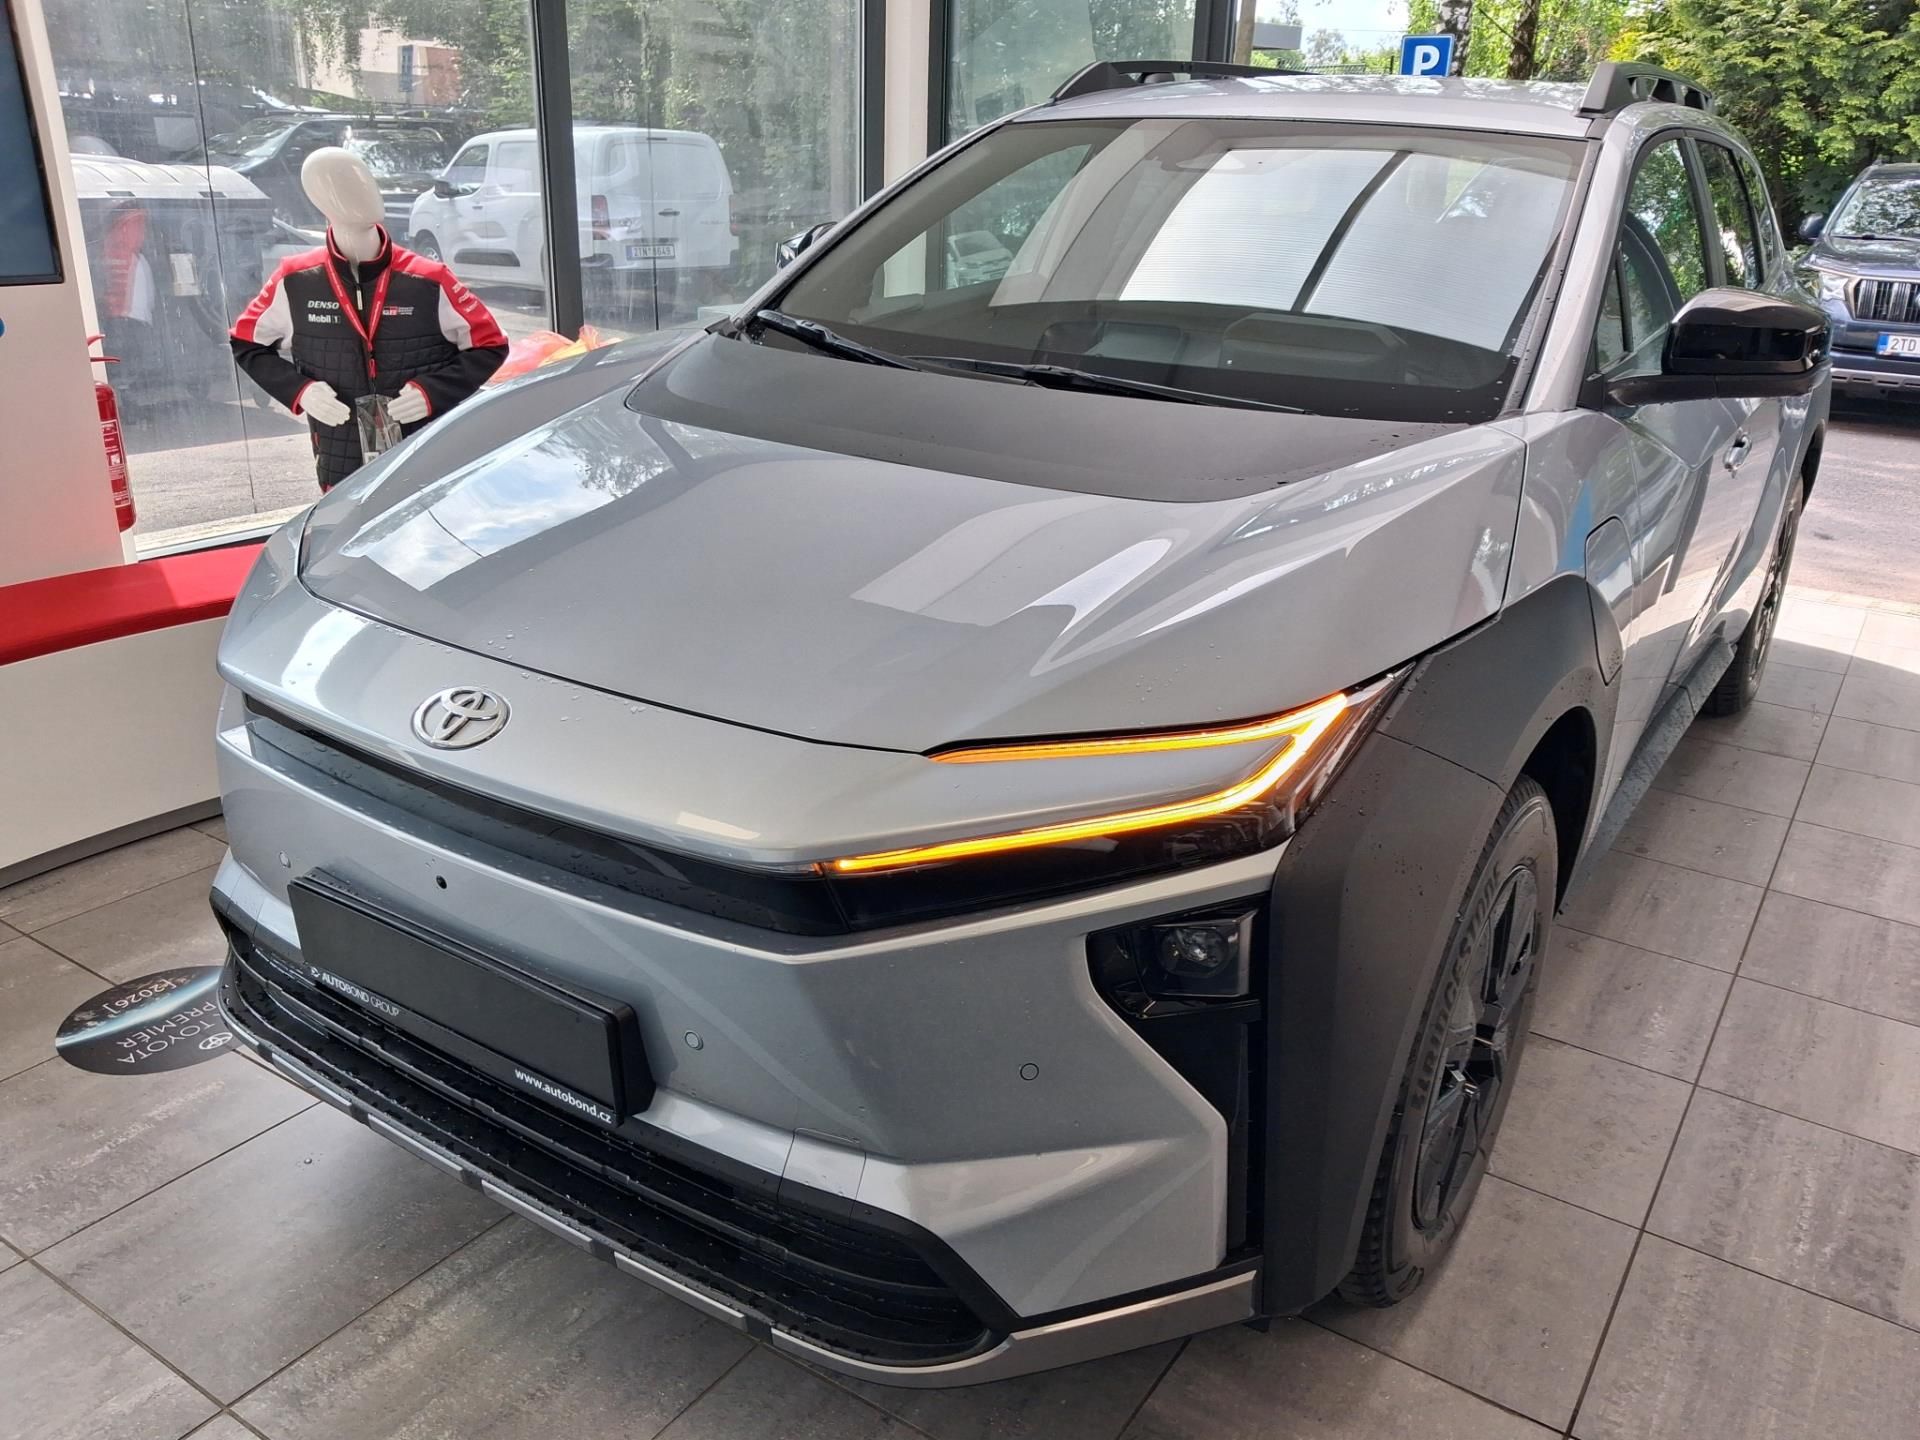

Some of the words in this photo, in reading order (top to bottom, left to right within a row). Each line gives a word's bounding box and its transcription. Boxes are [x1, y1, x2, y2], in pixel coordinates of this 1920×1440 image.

[1413, 45, 1440, 75] P
[307, 300, 340, 310] DENSO
[308, 313, 331, 323] Mobil
[1890, 337, 1917, 352] 2TD
[322, 972, 370, 1003] AUTOBOND
[370, 996, 399, 1017] GROUP
[117, 1001, 217, 1048] PREMIÉR
[117, 1021, 215, 1063] TOYOTA
[514, 1068, 612, 1124] www.autobond.cz
